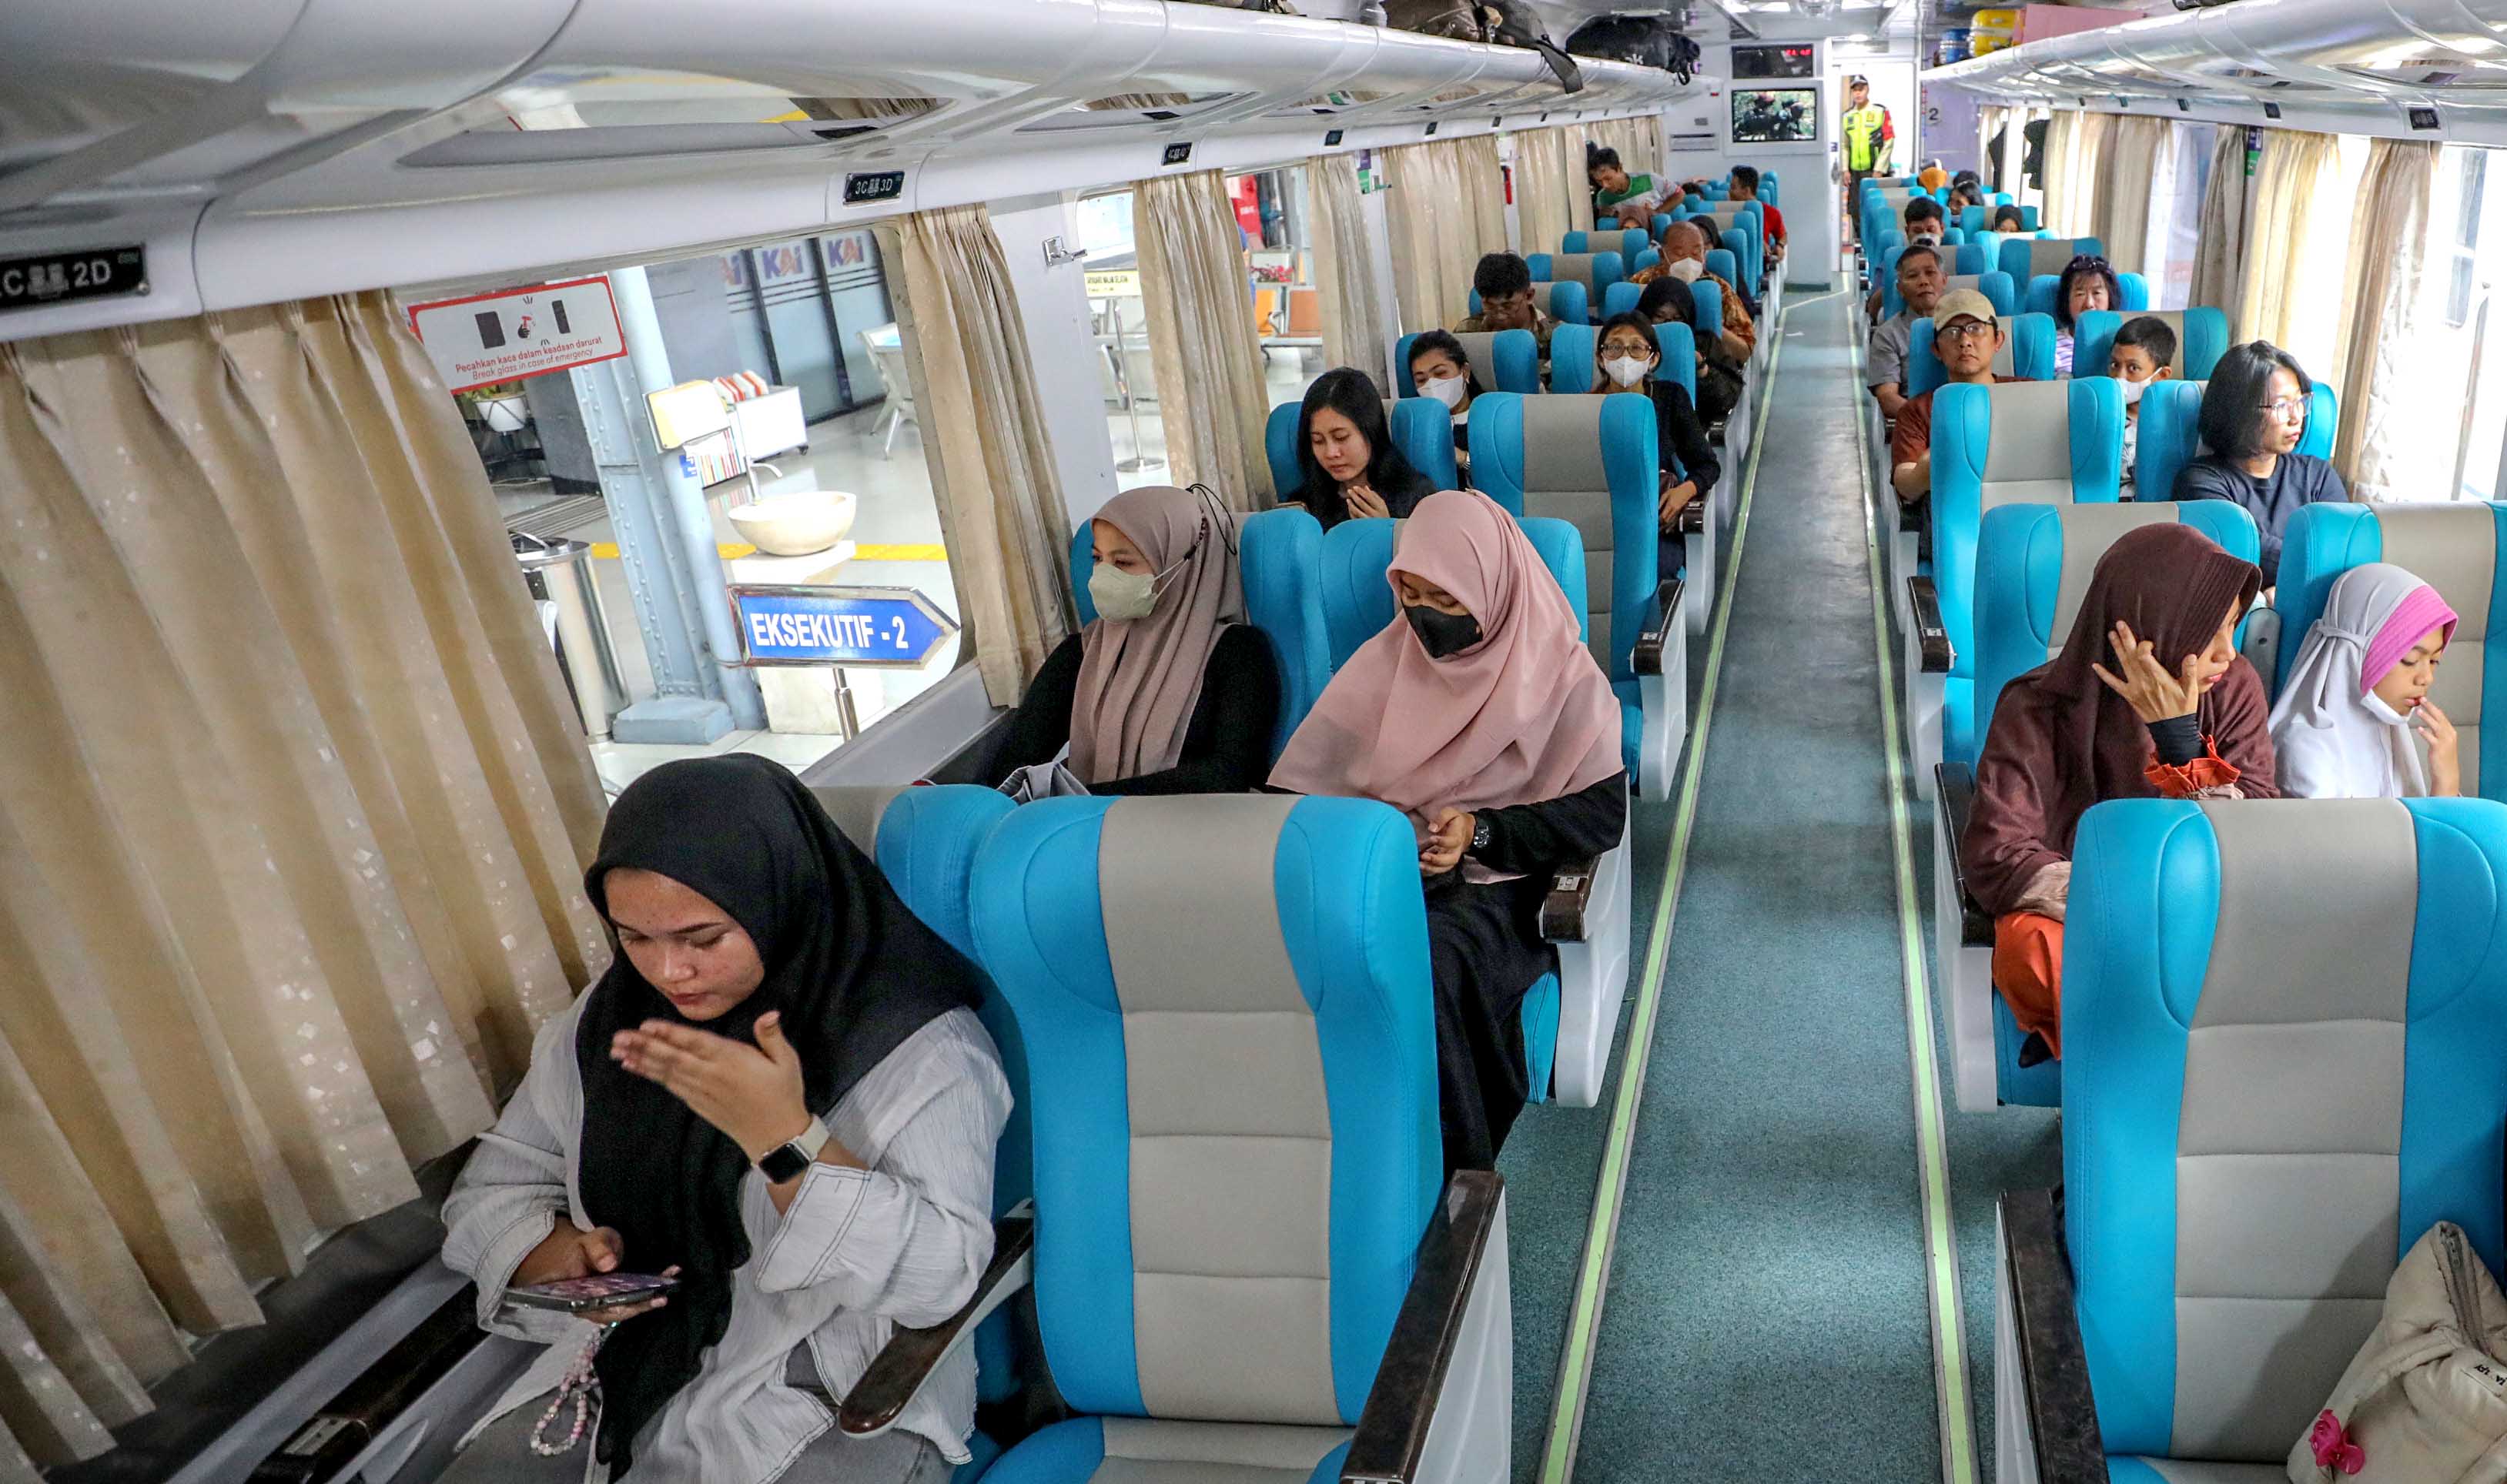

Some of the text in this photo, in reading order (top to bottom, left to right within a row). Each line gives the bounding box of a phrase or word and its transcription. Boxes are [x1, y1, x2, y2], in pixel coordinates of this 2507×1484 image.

[1929, 107, 1939, 121] 2
[855, 178, 893, 195] 3C 3D
[0, 269, 25, 297] C
[72, 258, 112, 288] 2D
[456, 336, 603, 373] Pecahkan kaca dalam keadaan darurat
[473, 348, 594, 380] Break glass in case of emergency
[750, 613, 875, 648] EKSEKUTIF
